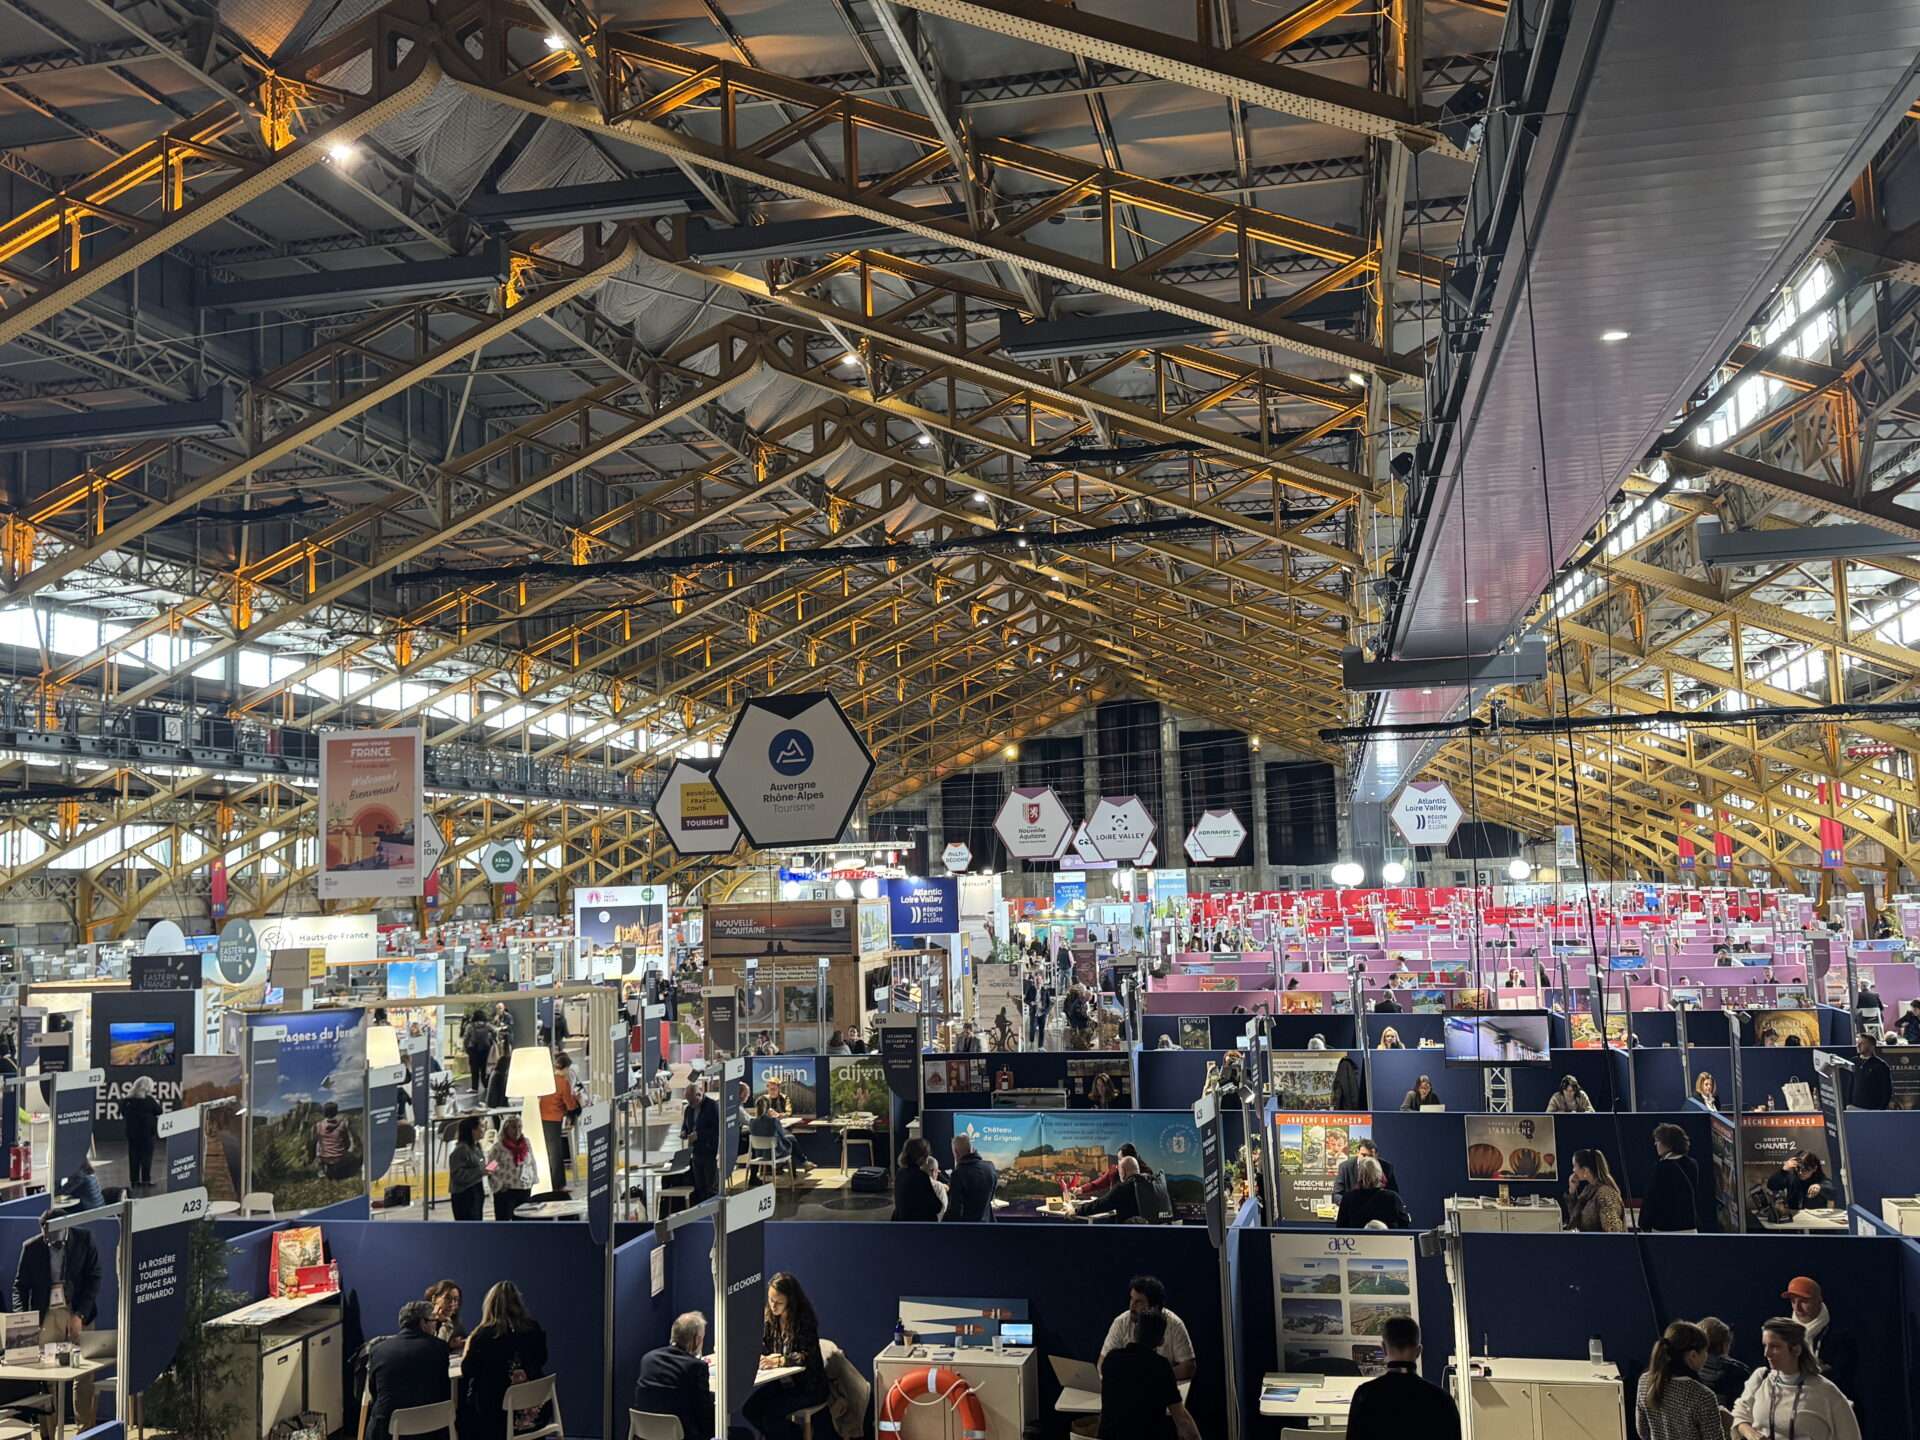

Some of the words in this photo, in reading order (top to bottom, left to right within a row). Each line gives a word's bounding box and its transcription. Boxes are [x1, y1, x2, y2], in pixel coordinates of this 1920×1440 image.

[351, 748, 392, 758] FRANCE
[770, 782, 817, 792] Auvergne
[349, 783, 401, 801] Bienvenue!
[763, 791, 825, 803] Rhône-Alpes
[1417, 797, 1447, 805] Atlantic
[773, 803, 816, 813] Tourisme
[1425, 804, 1448, 812] Valley
[686, 818, 724, 827] TOURISME
[1118, 832, 1145, 840] VALLEY
[913, 888, 943, 896] Atlantic
[901, 895, 919, 904] Loire
[919, 895, 943, 904] Valley
[715, 919, 758, 928] NOUVELLE-
[725, 926, 766, 935] AQUITAINE
[220, 953, 243, 961] FRANCE
[143, 974, 178, 982] EASTERN
[143, 980, 172, 988] FRANCE
[319, 1027, 333, 1040] du
[95, 1080, 183, 1100] EASERN
[1286, 1116, 1318, 1124] ARDÈCHE
[1783, 1117, 1816, 1125] AMAZED
[161, 1120, 173, 1131] A24
[982, 1126, 1013, 1134] Château
[1754, 1142, 1789, 1150] CHAUVET
[1789, 1141, 1797, 1150] 2
[182, 1199, 202, 1214] A23
[758, 1196, 772, 1213] A25
[138, 1261, 147, 1271] LA
[148, 1253, 176, 1267] ROSIÈRE
[140, 1265, 174, 1280] TOURISME
[135, 1280, 161, 1293] ESPACE
[163, 1275, 177, 1285] SAN
[728, 1285, 733, 1295] LE
[733, 1282, 739, 1292] K2
[740, 1271, 762, 1287] CHOGORI
[136, 1287, 174, 1304] BERNARDO
